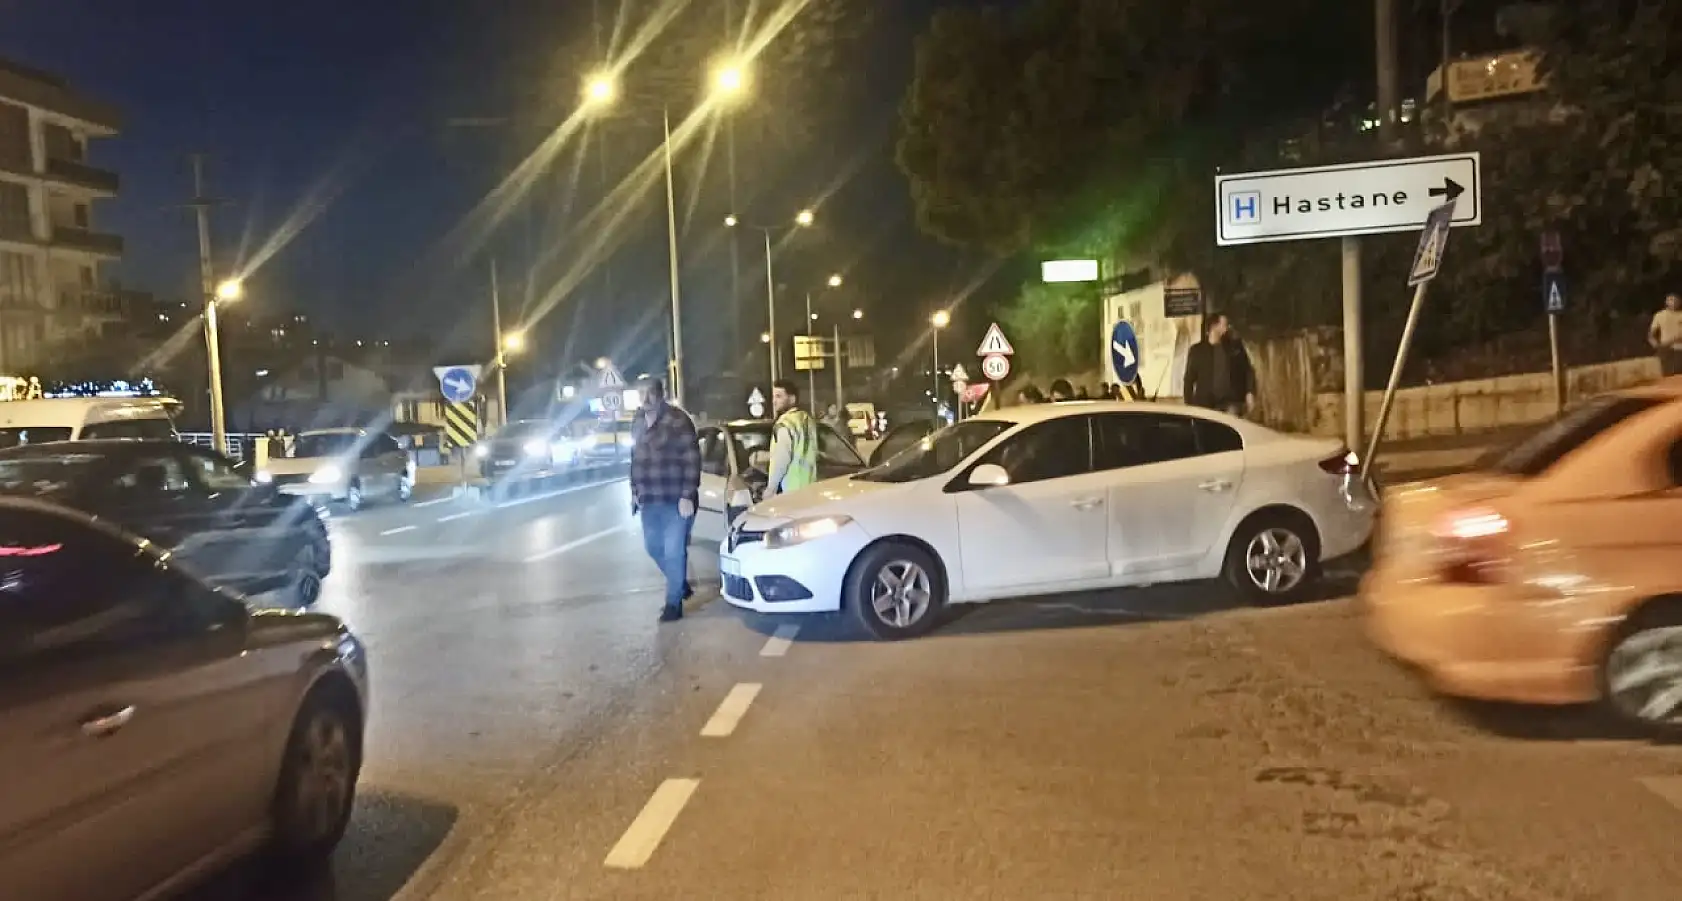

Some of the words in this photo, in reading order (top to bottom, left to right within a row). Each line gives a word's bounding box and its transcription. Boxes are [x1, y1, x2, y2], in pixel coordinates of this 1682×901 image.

[1235, 197, 1255, 219] H
[1273, 190, 1408, 215] Hastane
[989, 362, 1004, 373] 50
[604, 395, 619, 405] 50
